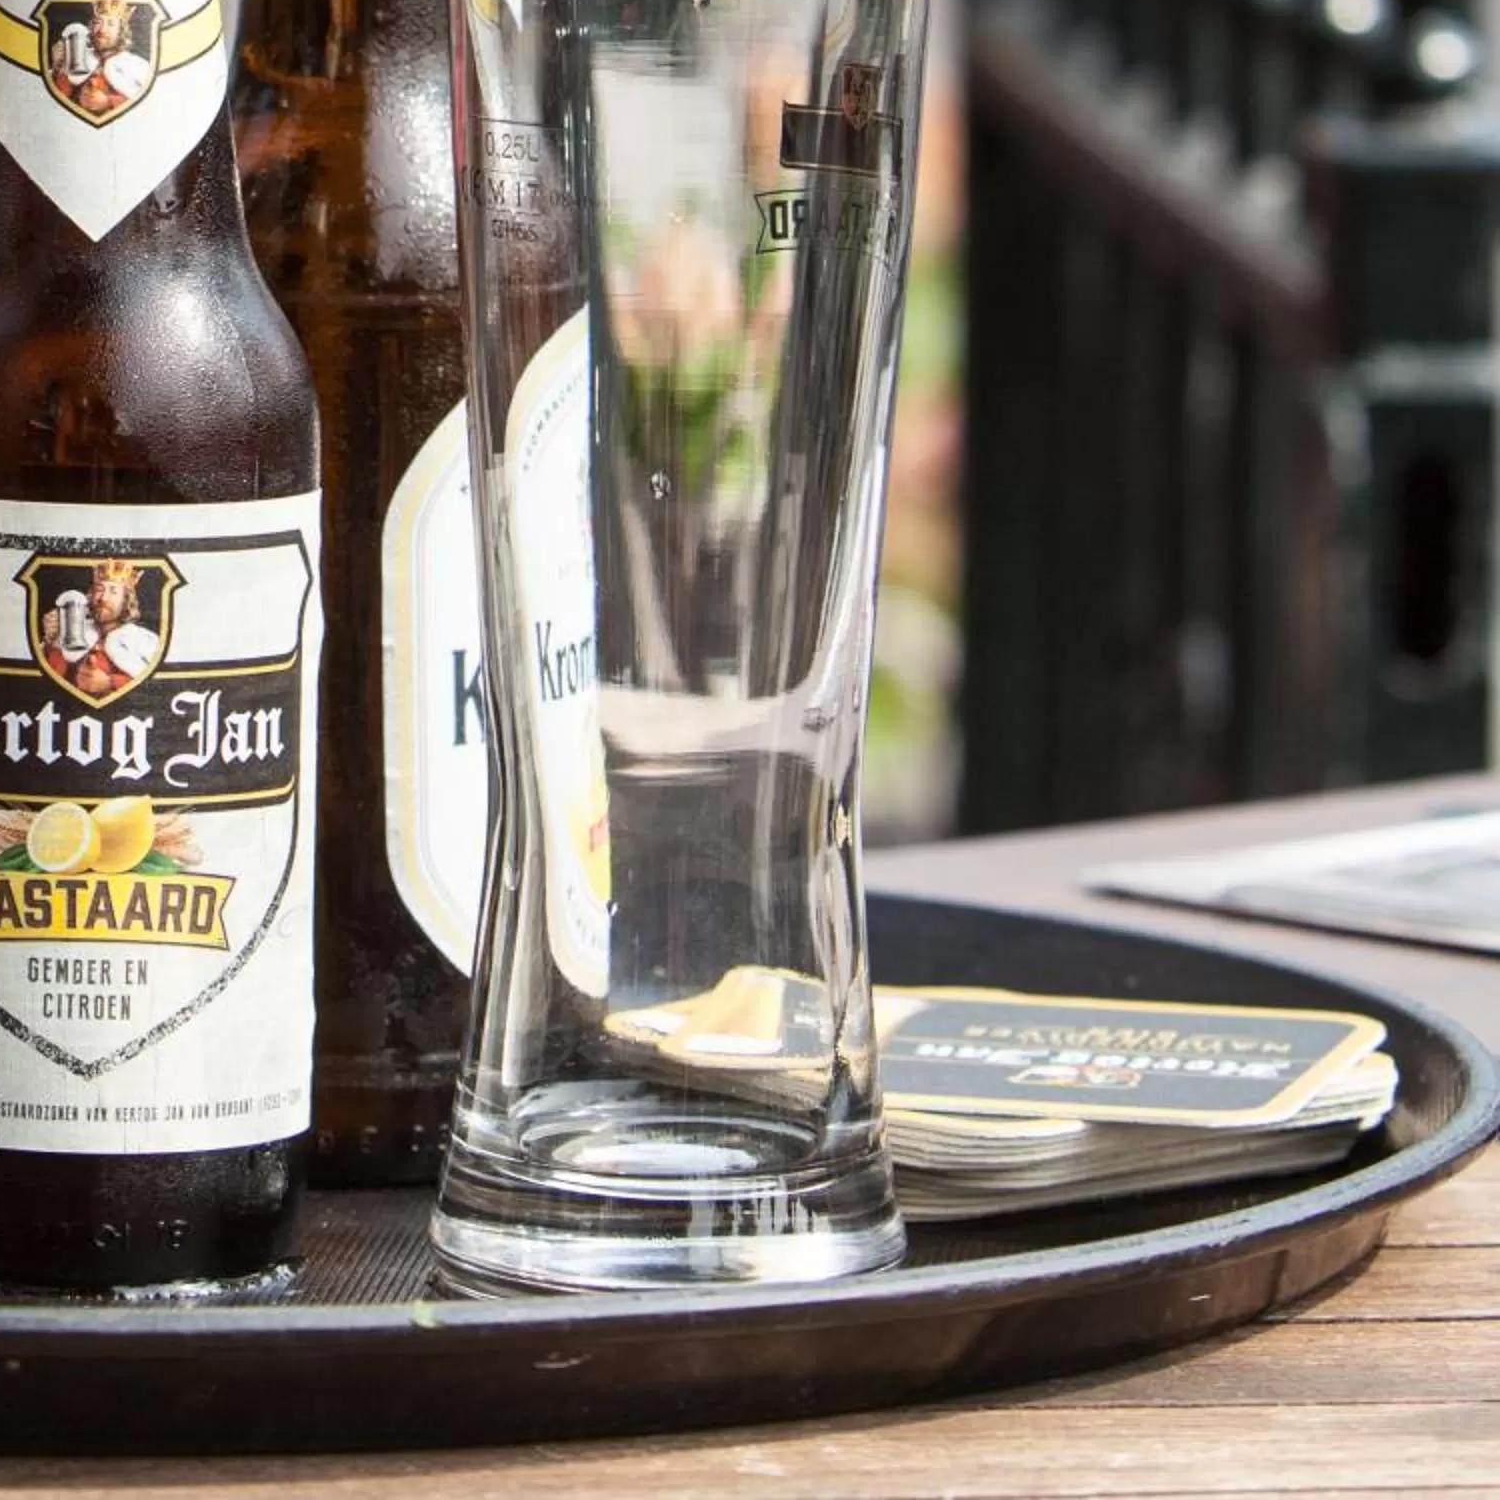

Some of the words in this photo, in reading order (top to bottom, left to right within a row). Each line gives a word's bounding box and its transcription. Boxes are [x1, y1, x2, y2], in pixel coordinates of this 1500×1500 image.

[163, 690, 286, 788] Jan
[27, 957, 112, 985] GEMBER
[125, 959, 149, 985] EN
[43, 993, 132, 1021] CITROEN
